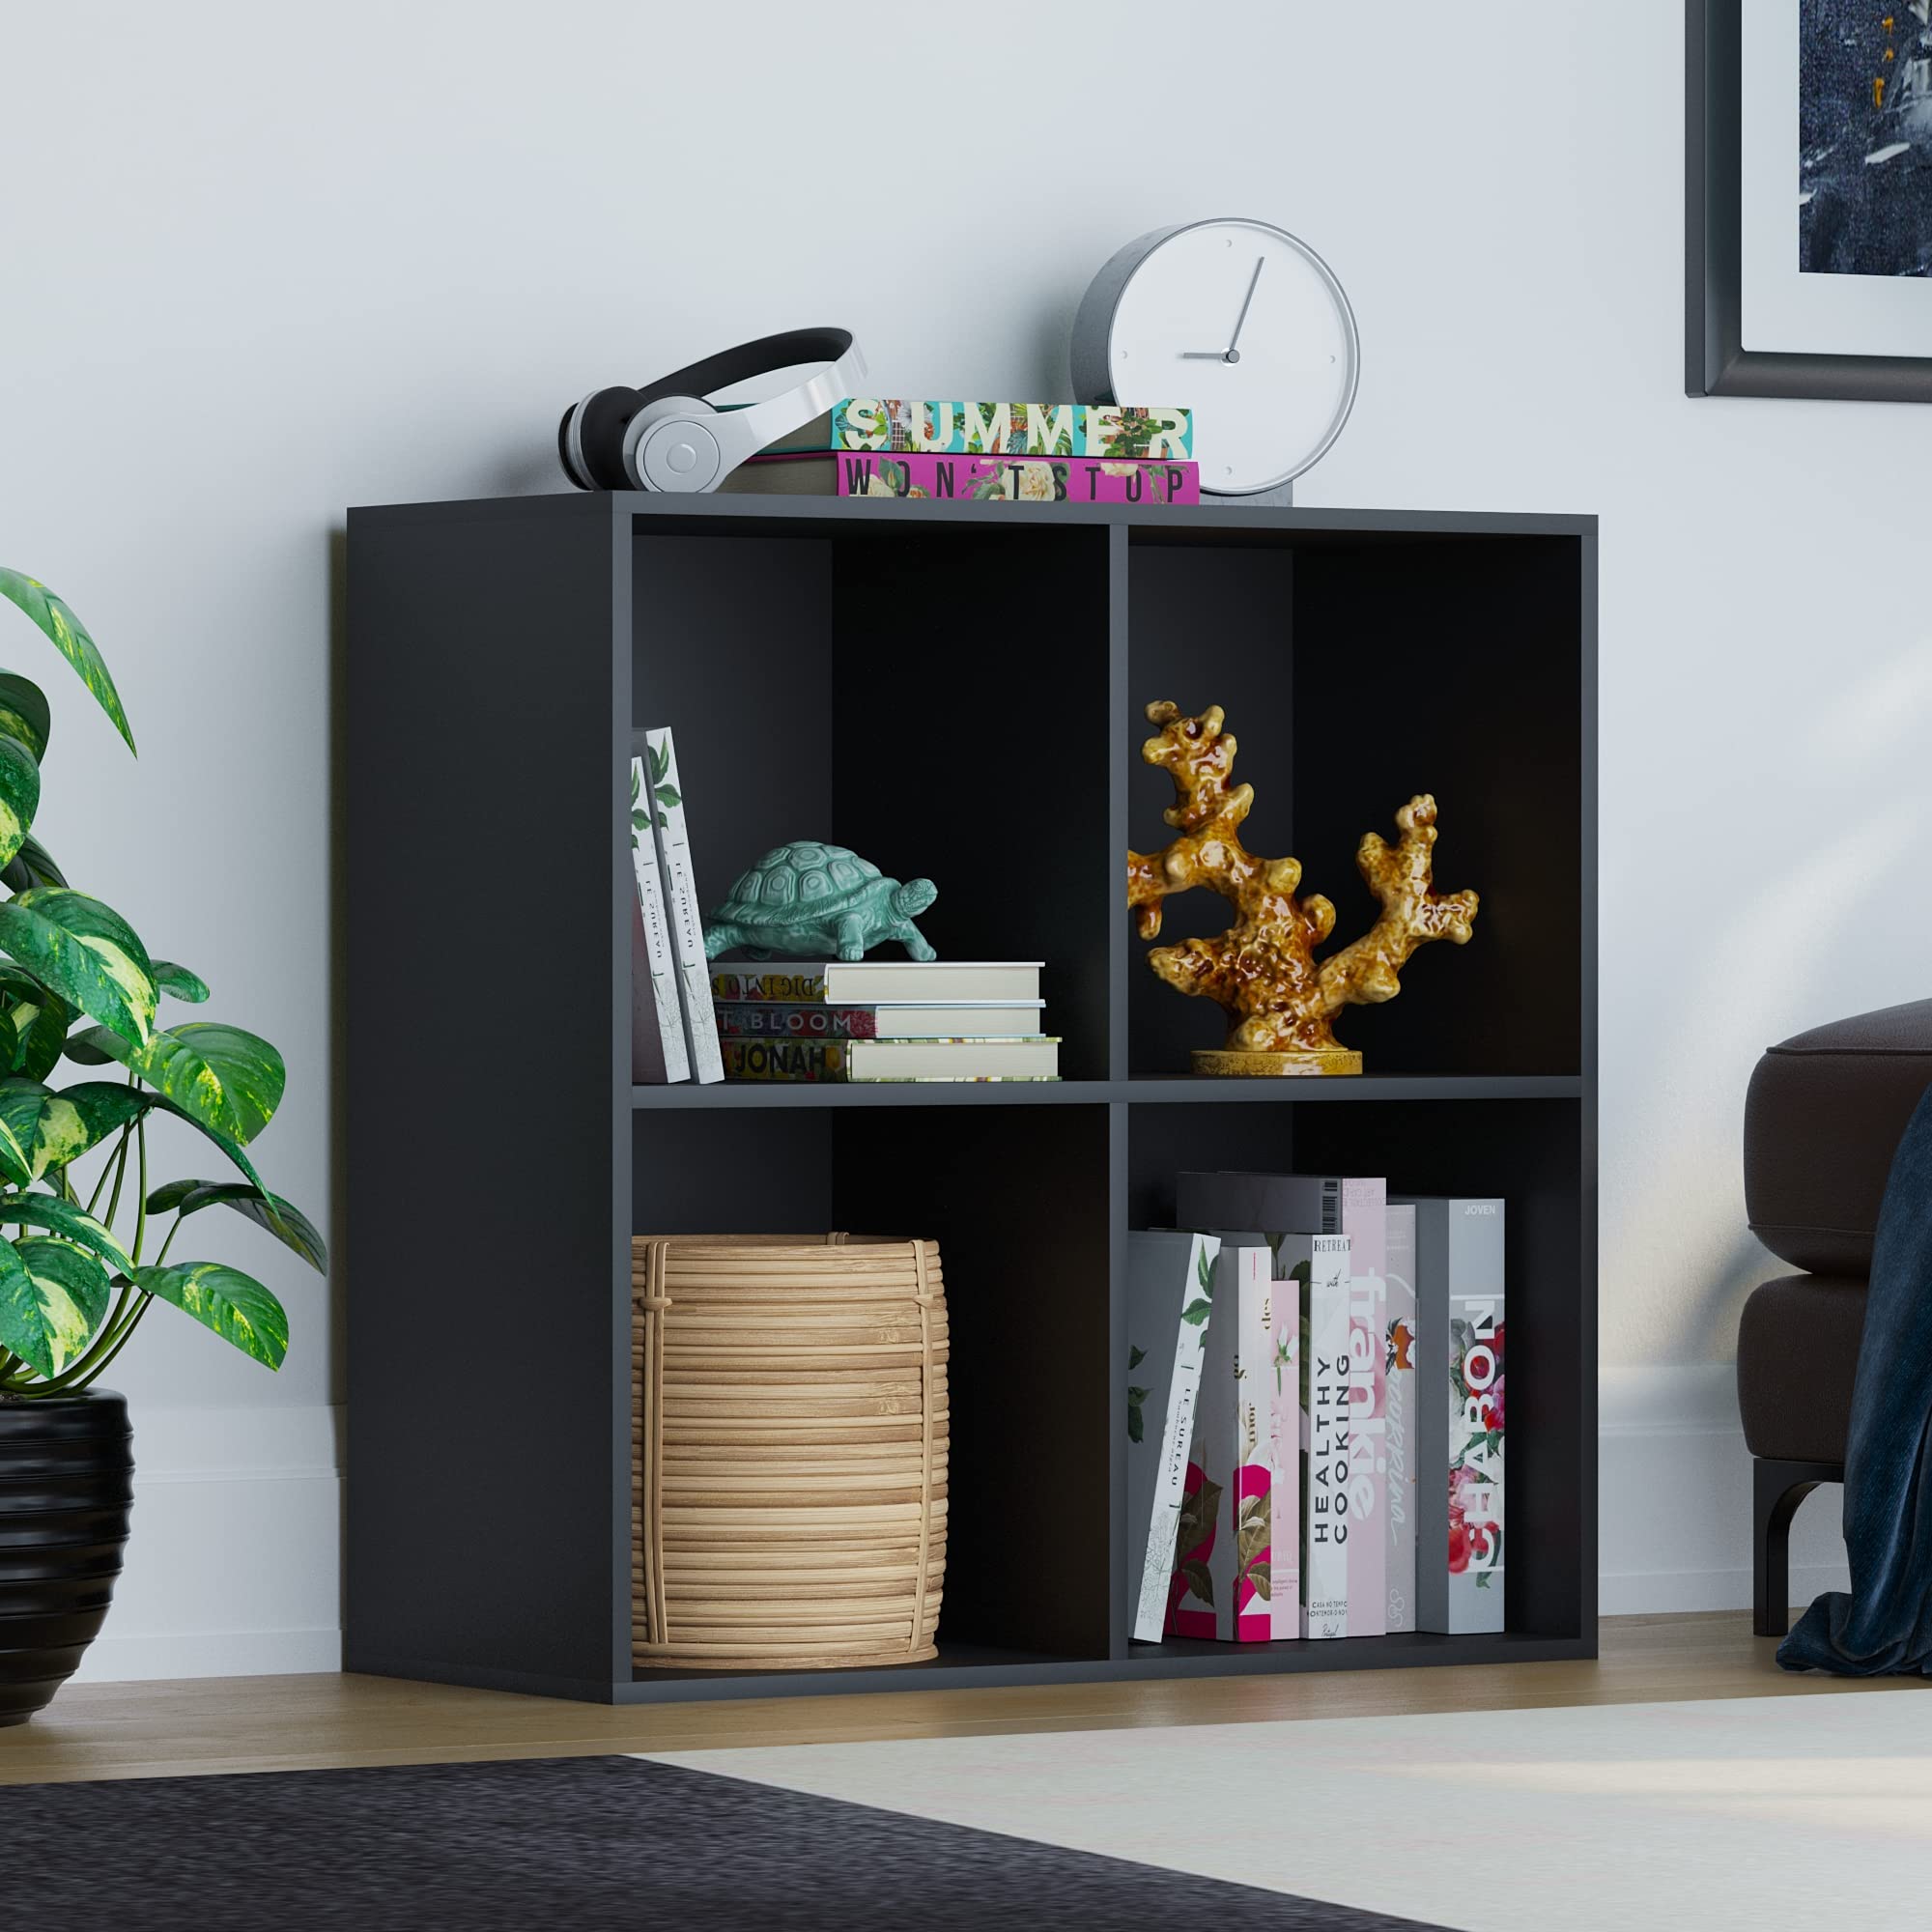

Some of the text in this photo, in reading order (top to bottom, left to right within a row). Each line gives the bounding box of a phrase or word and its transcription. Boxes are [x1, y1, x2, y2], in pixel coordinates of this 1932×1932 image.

[845, 399, 1189, 459] SUMMER
[1053, 466, 1183, 503] STOP
[751, 1012, 852, 1031] BLOOM
[734, 1042, 826, 1074] JONAH
[1464, 1205, 1496, 1215] JOVEN
[1314, 1239, 1350, 1252] RETREAT
[1349, 1267, 1386, 1521] frankie
[1171, 1416, 1187, 1487] SUREAU
[1315, 1357, 1331, 1544] HEALTHY
[1334, 1354, 1350, 1545] COOKING
[1463, 1300, 1496, 1574] CHABON
